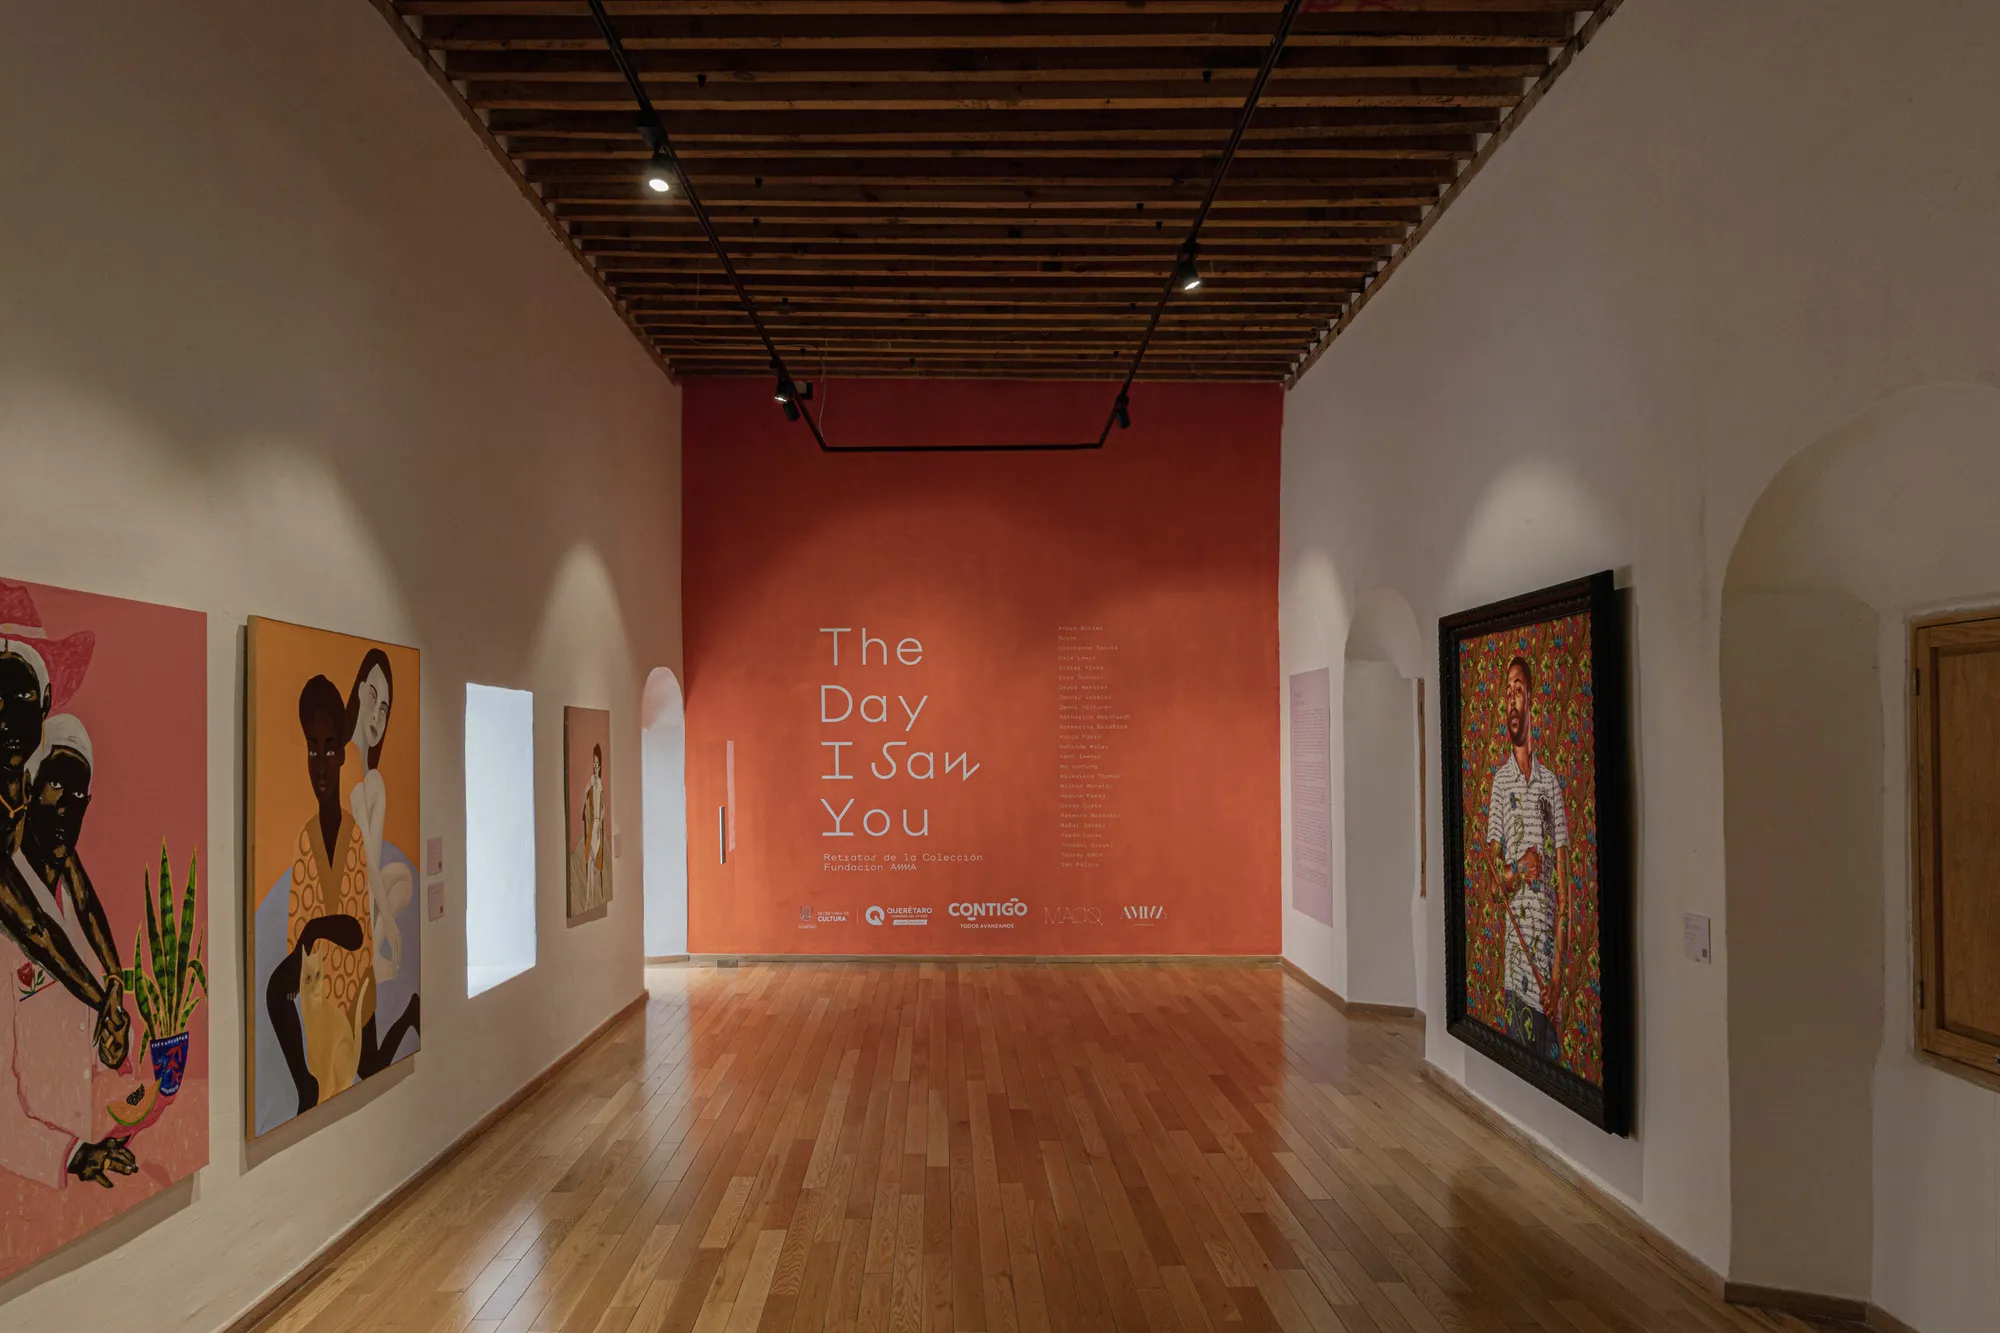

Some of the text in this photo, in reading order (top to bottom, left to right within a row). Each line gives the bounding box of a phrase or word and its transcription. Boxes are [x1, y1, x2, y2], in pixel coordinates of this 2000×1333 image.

[819, 627, 923, 666] The
[820, 684, 928, 732] Day
[820, 741, 980, 781] I Saw
[820, 798, 929, 837] You
[823, 852, 983, 862] Retratos de la Colección
[823, 863, 918, 872] Fundacion AMMA
[886, 906, 933, 914] QUERÉTARO
[948, 898, 1028, 921] CONTIGO
